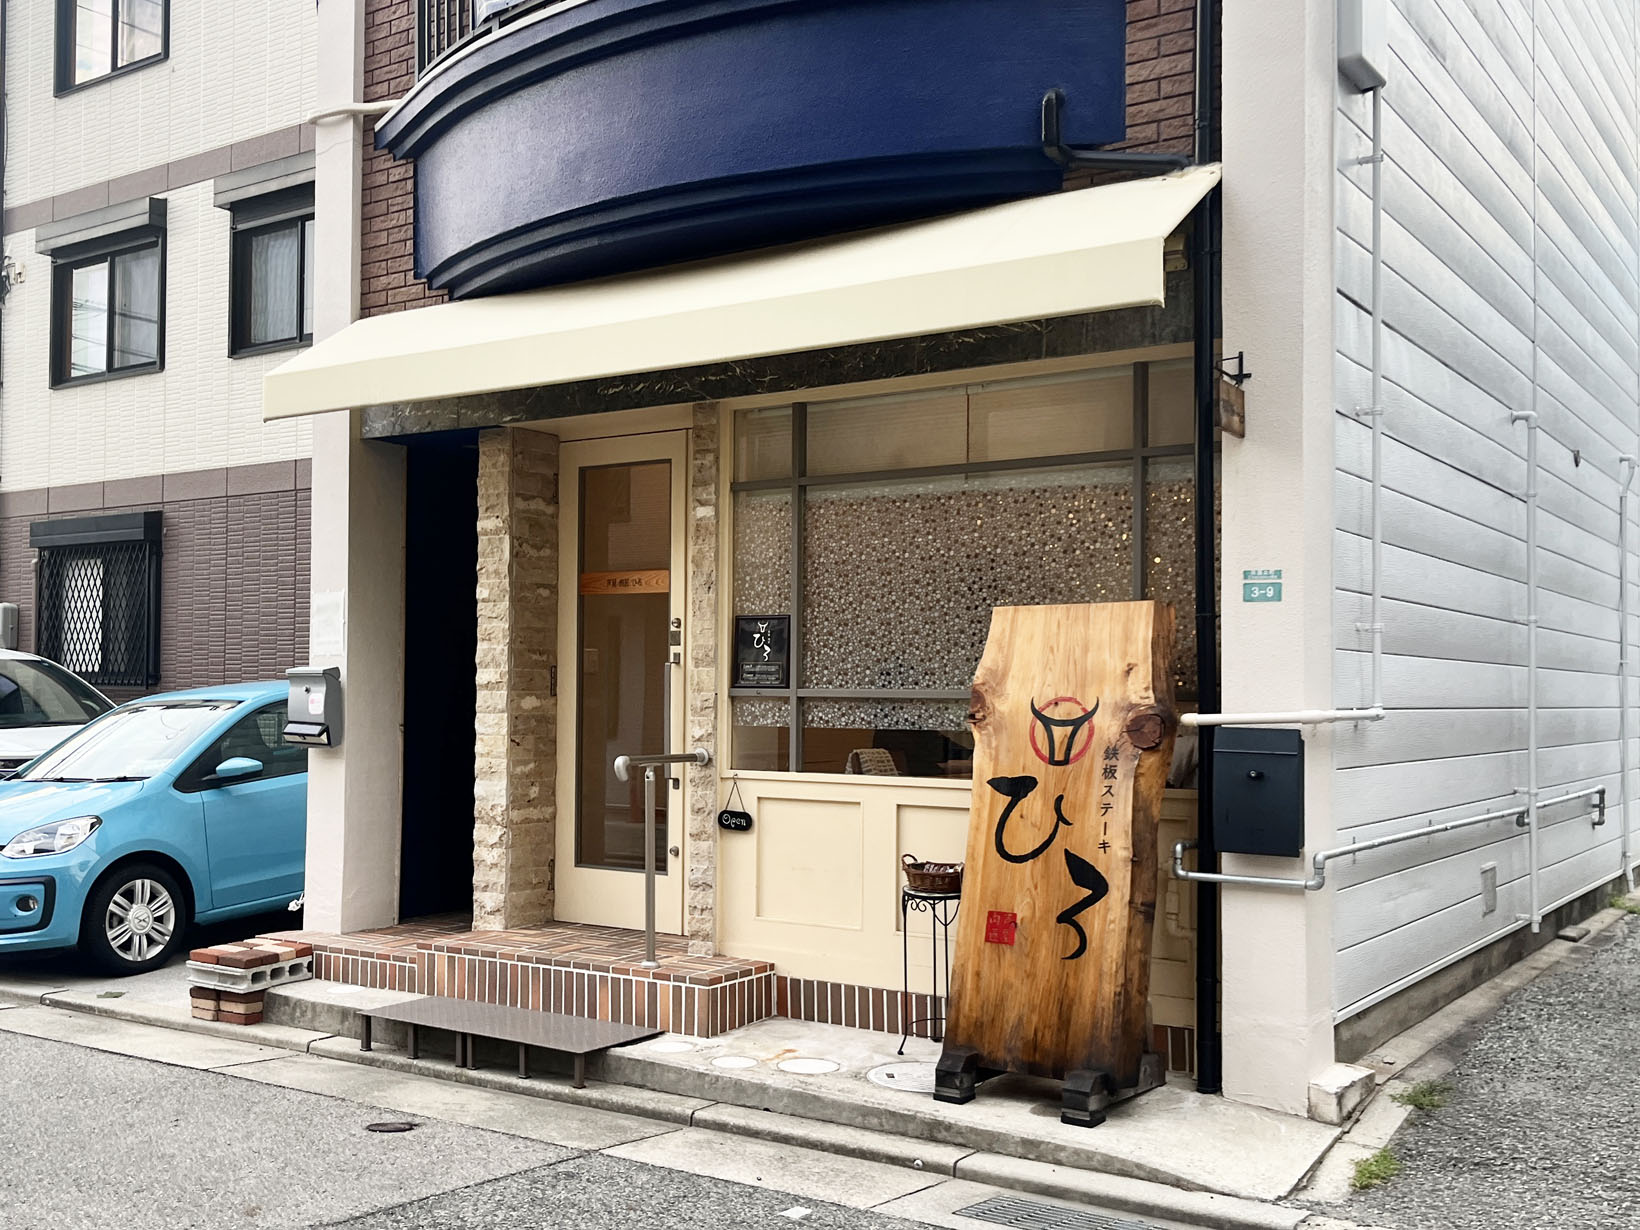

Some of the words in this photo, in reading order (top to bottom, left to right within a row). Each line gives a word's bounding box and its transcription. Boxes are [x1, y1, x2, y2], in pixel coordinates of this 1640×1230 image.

[1251, 586, 1274, 598] 3-9
[722, 813, 747, 828] Open
[1098, 745, 1120, 855] 鉄板ステーキ
[986, 775, 1109, 960] ひろ
